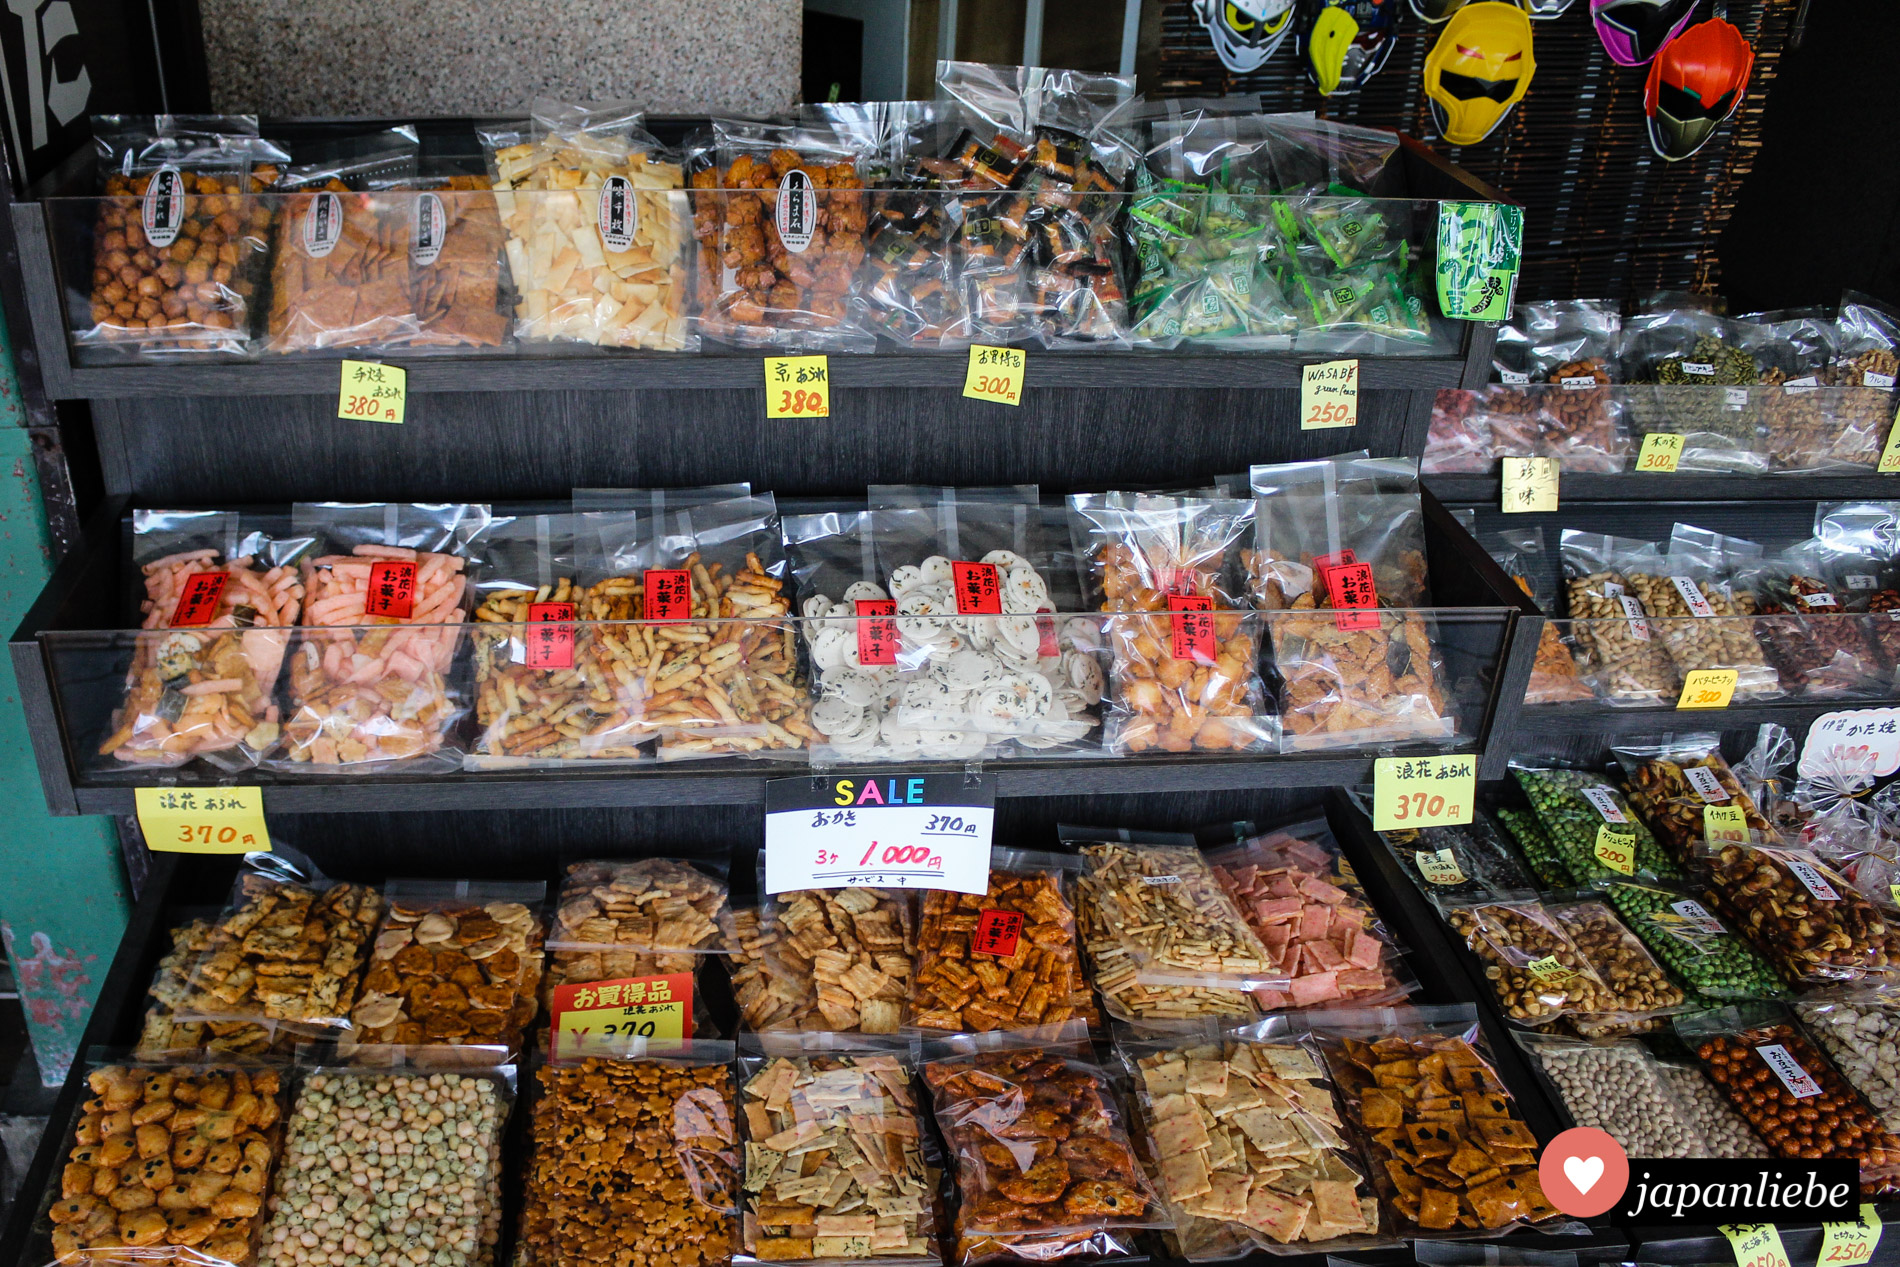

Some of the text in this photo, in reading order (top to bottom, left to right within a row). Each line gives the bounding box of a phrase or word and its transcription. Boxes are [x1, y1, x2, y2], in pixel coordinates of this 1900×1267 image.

[978, 350, 1021, 368] お買得品
[372, 386, 403, 400] あられ
[378, 569, 397, 610] お菓子
[398, 567, 412, 600] 浪花の
[674, 575, 687, 604] 浪花の
[966, 569, 983, 608] お菓子
[981, 567, 995, 596] 浪花の
[1357, 569, 1371, 604] 浪花の
[184, 581, 208, 619] お菓子
[656, 579, 673, 617] お菓子
[1341, 575, 1361, 622] お菓子
[539, 612, 554, 660] お菓子
[869, 609, 883, 657] お菓子
[1182, 606, 1197, 650] お菓子
[1695, 690, 1722, 703] 300
[1396, 760, 1471, 779] 浪花 あられ
[834, 779, 925, 806] SALE
[1394, 792, 1460, 819] 370円
[178, 825, 256, 845] 370円
[811, 811, 976, 833] おかき 370円
[847, 876, 906, 885] サービス 中
[985, 917, 1005, 949] お菓子
[1003, 915, 1019, 941] 浪花の
[574, 980, 672, 1009] お買得品
[649, 1004, 675, 1014] あられ
